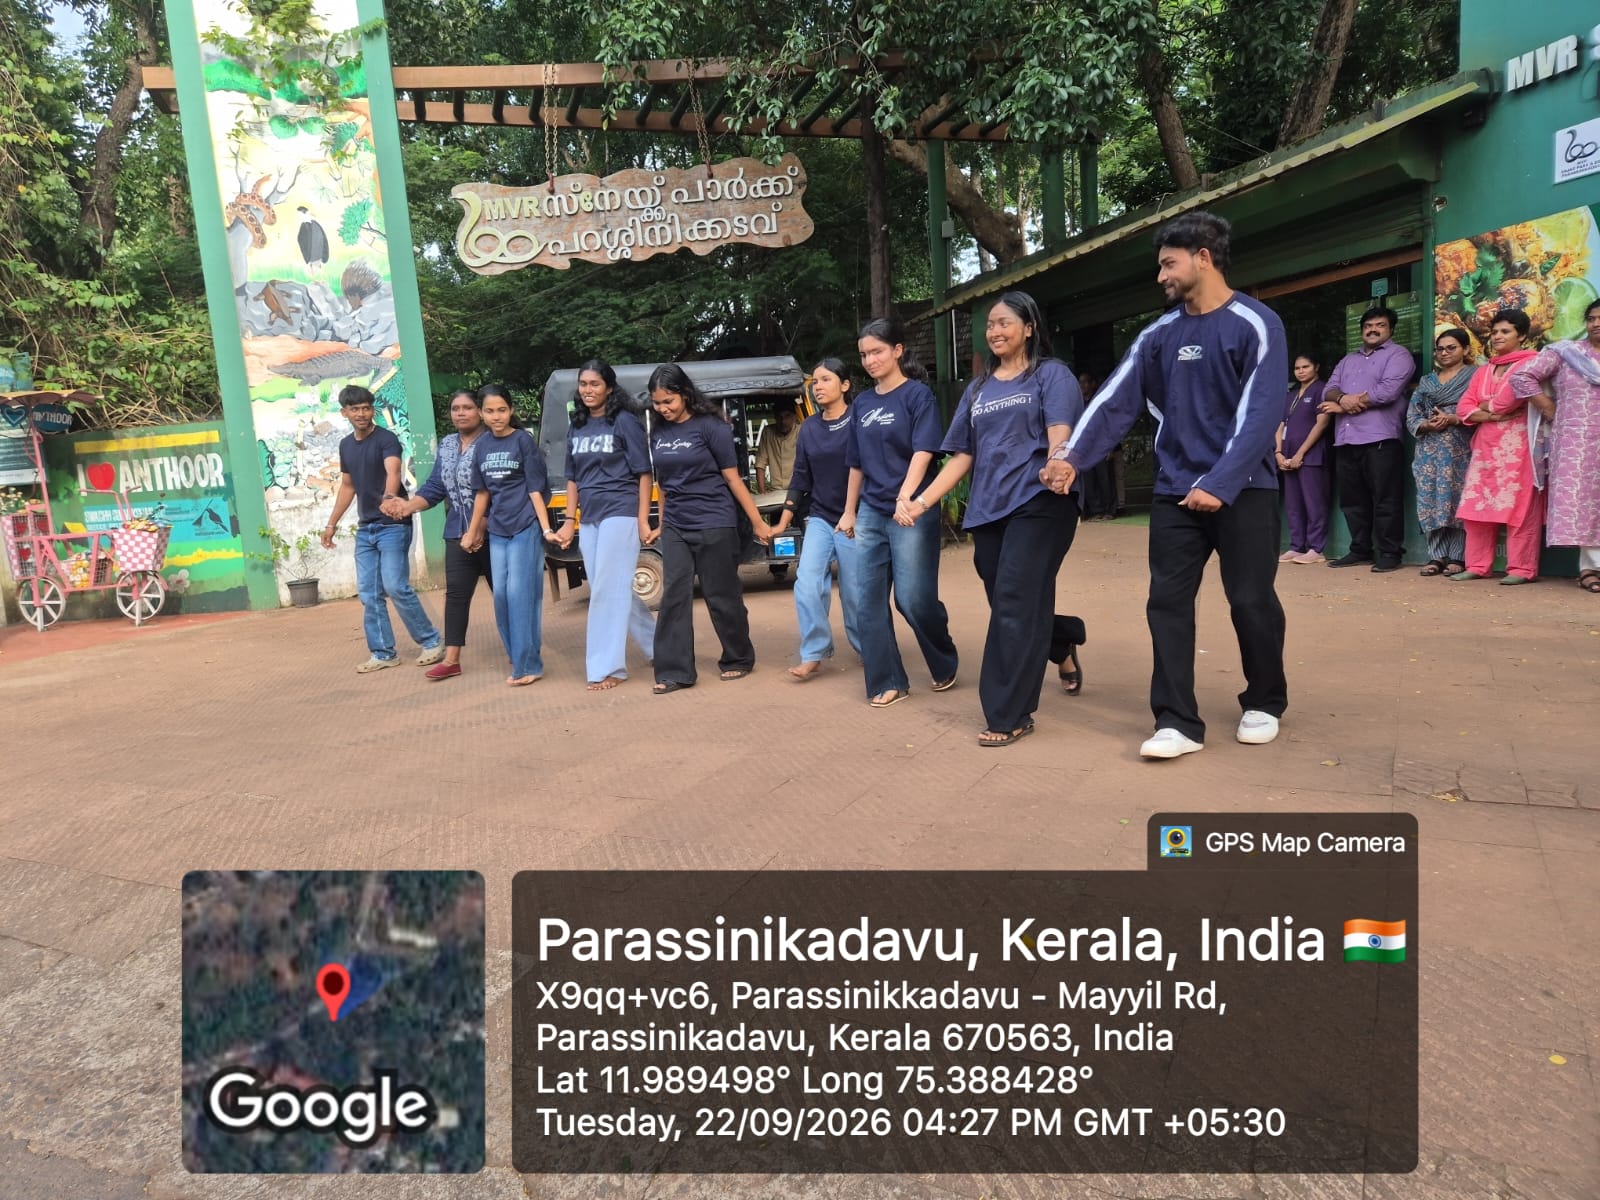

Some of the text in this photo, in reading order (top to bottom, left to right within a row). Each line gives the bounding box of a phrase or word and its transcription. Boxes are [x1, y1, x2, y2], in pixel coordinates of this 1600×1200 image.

[1505, 34, 1578, 92] MVR
[671, 165, 799, 204] പാർക്ക്
[481, 195, 541, 221] MVR
[548, 201, 783, 261] പറശ്ശിനിക്കടവ്
[972, 407, 983, 417] DO
[984, 396, 1026, 414] ANYTHING
[119, 452, 225, 493] ANTHOOR
